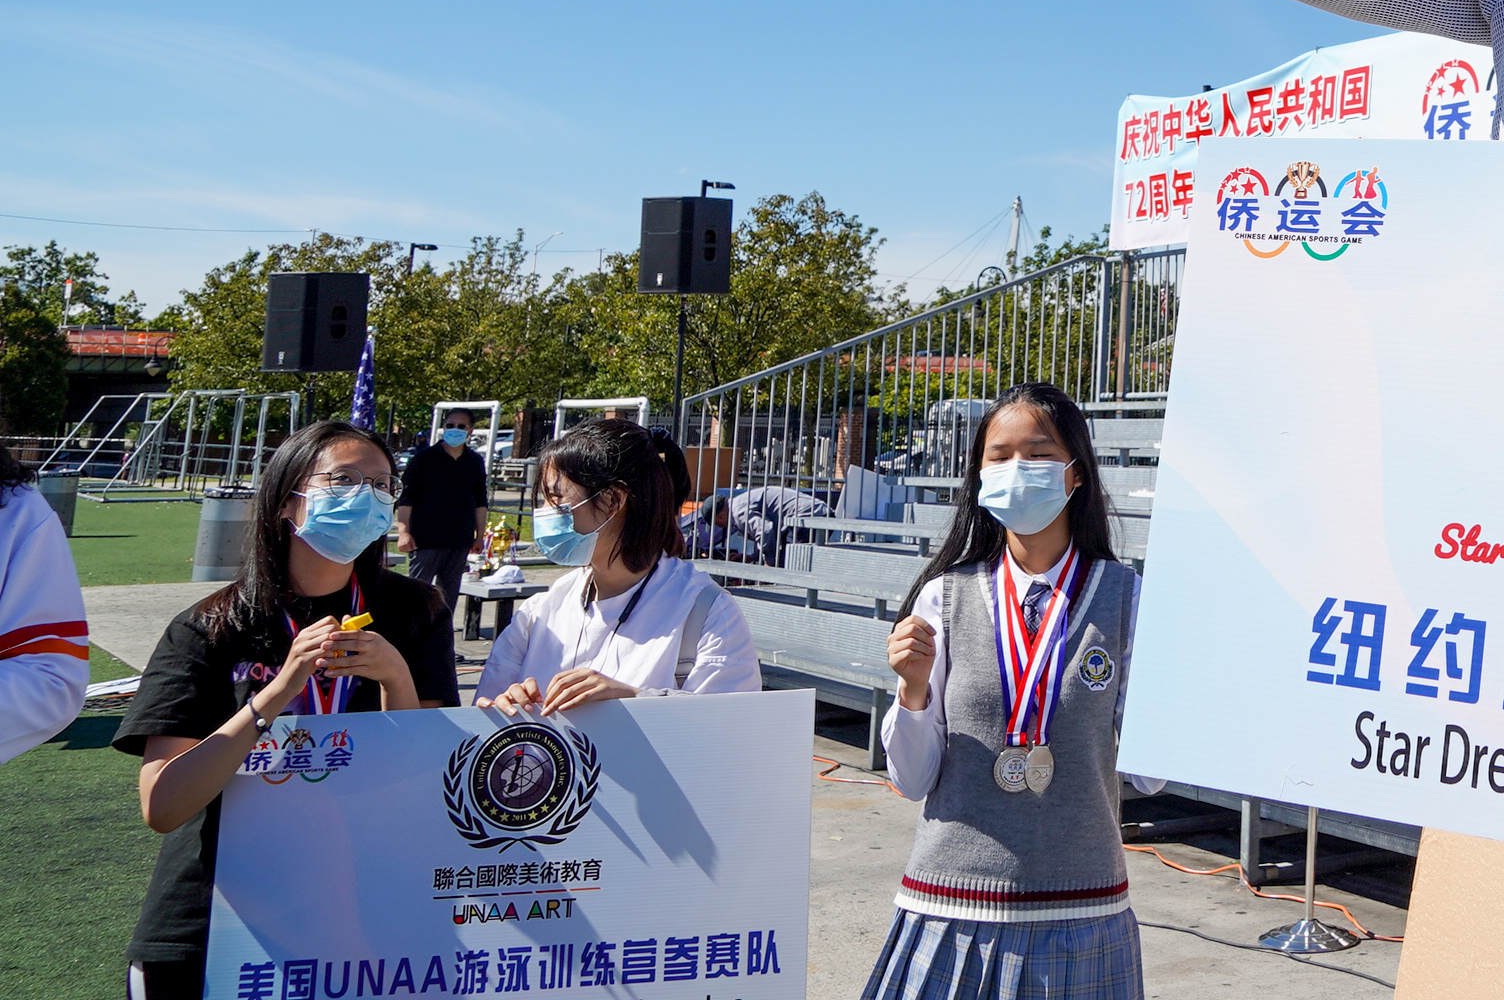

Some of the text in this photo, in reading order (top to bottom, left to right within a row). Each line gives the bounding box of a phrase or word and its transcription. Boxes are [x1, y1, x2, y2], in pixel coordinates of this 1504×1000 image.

[1119, 64, 1373, 163] 庆祝中华人民共和国
[1216, 197, 1387, 238] 侨运会
[1234, 231, 1363, 244] CHINESE AMERICAN SPORTS GAME
[243, 747, 354, 772] 侨运会
[476, 730, 568, 791] United Nations Artists Associates Inc.
[1350, 710, 1431, 778] Star
[511, 814, 528, 822] 2011
[433, 858, 603, 891] 聯合國際美術教育
[452, 897, 577, 926] UNAA ART
[237, 929, 781, 1000] 美国UNAA游泳训练营参赛队
